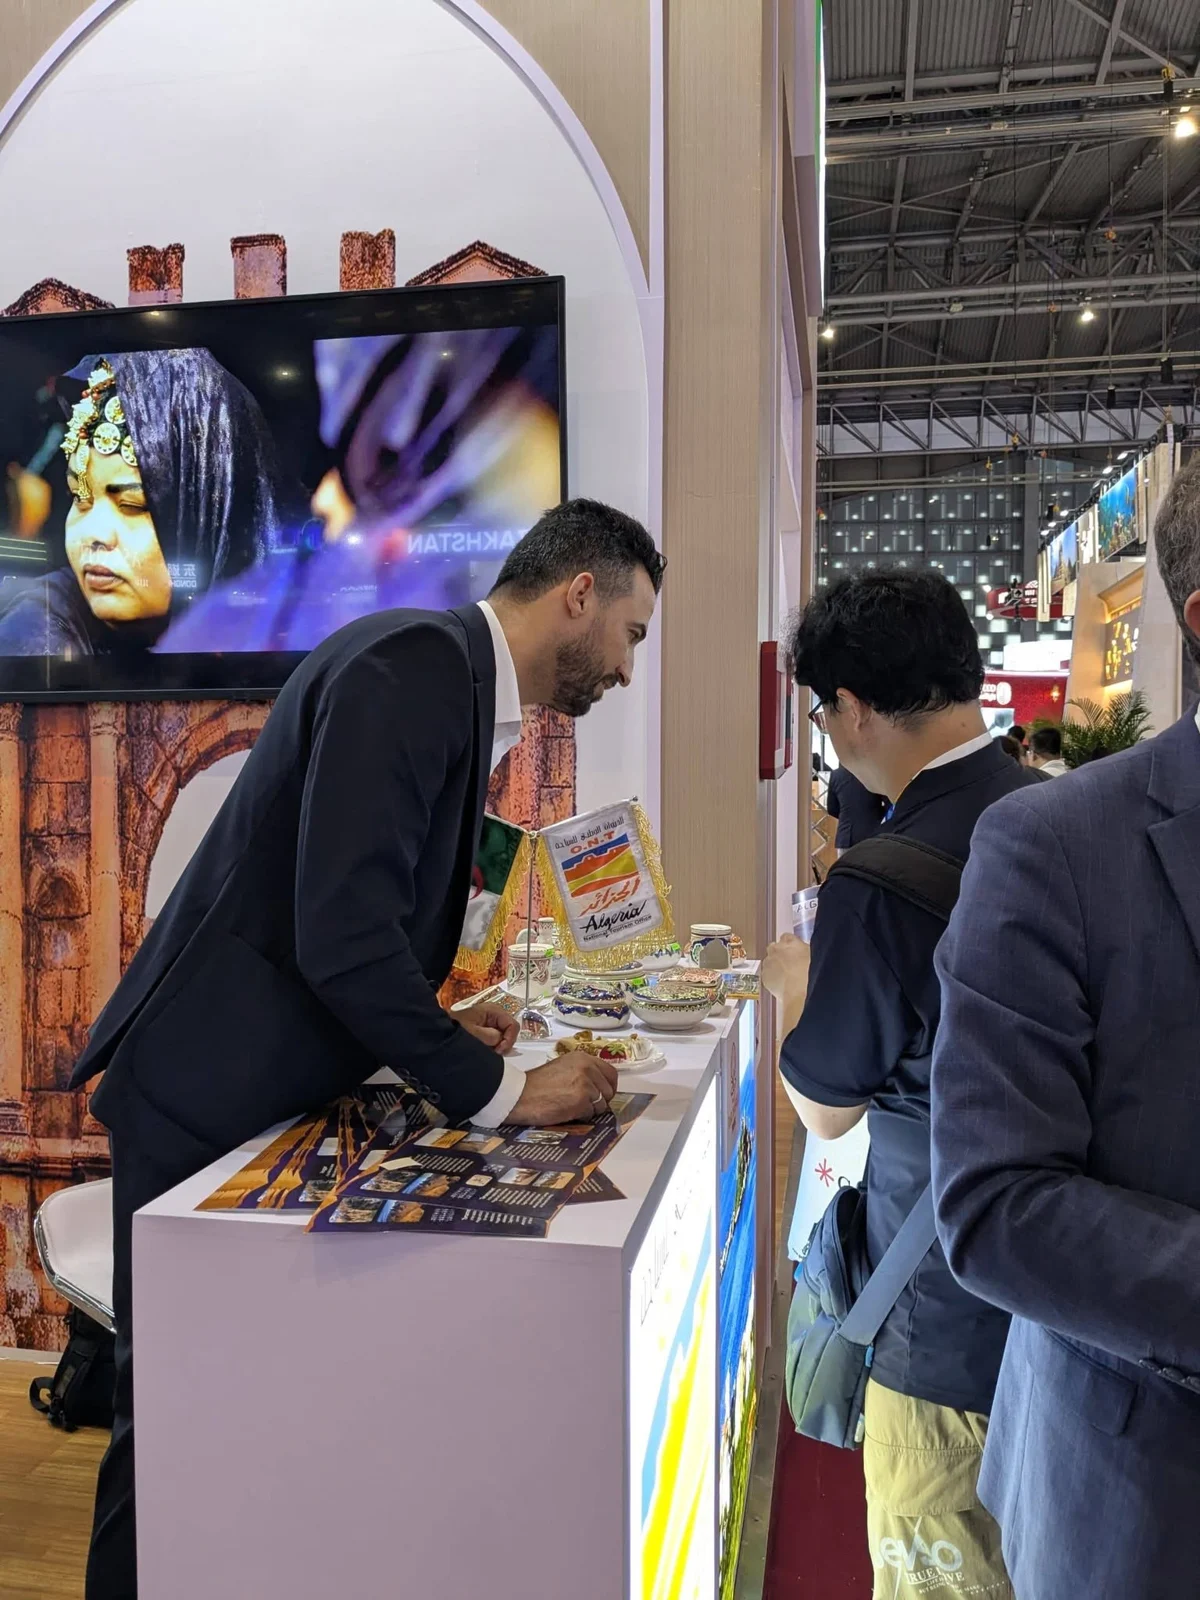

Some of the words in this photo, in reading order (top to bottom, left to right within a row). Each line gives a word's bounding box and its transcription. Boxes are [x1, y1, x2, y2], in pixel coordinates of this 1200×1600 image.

[570, 830, 616, 854] O.N.T
[577, 877, 641, 917] الجزائر
[579, 900, 647, 935] Algeria
[583, 931, 608, 942] National
[610, 922, 634, 936] Tourism
[634, 915, 652, 926] Office
